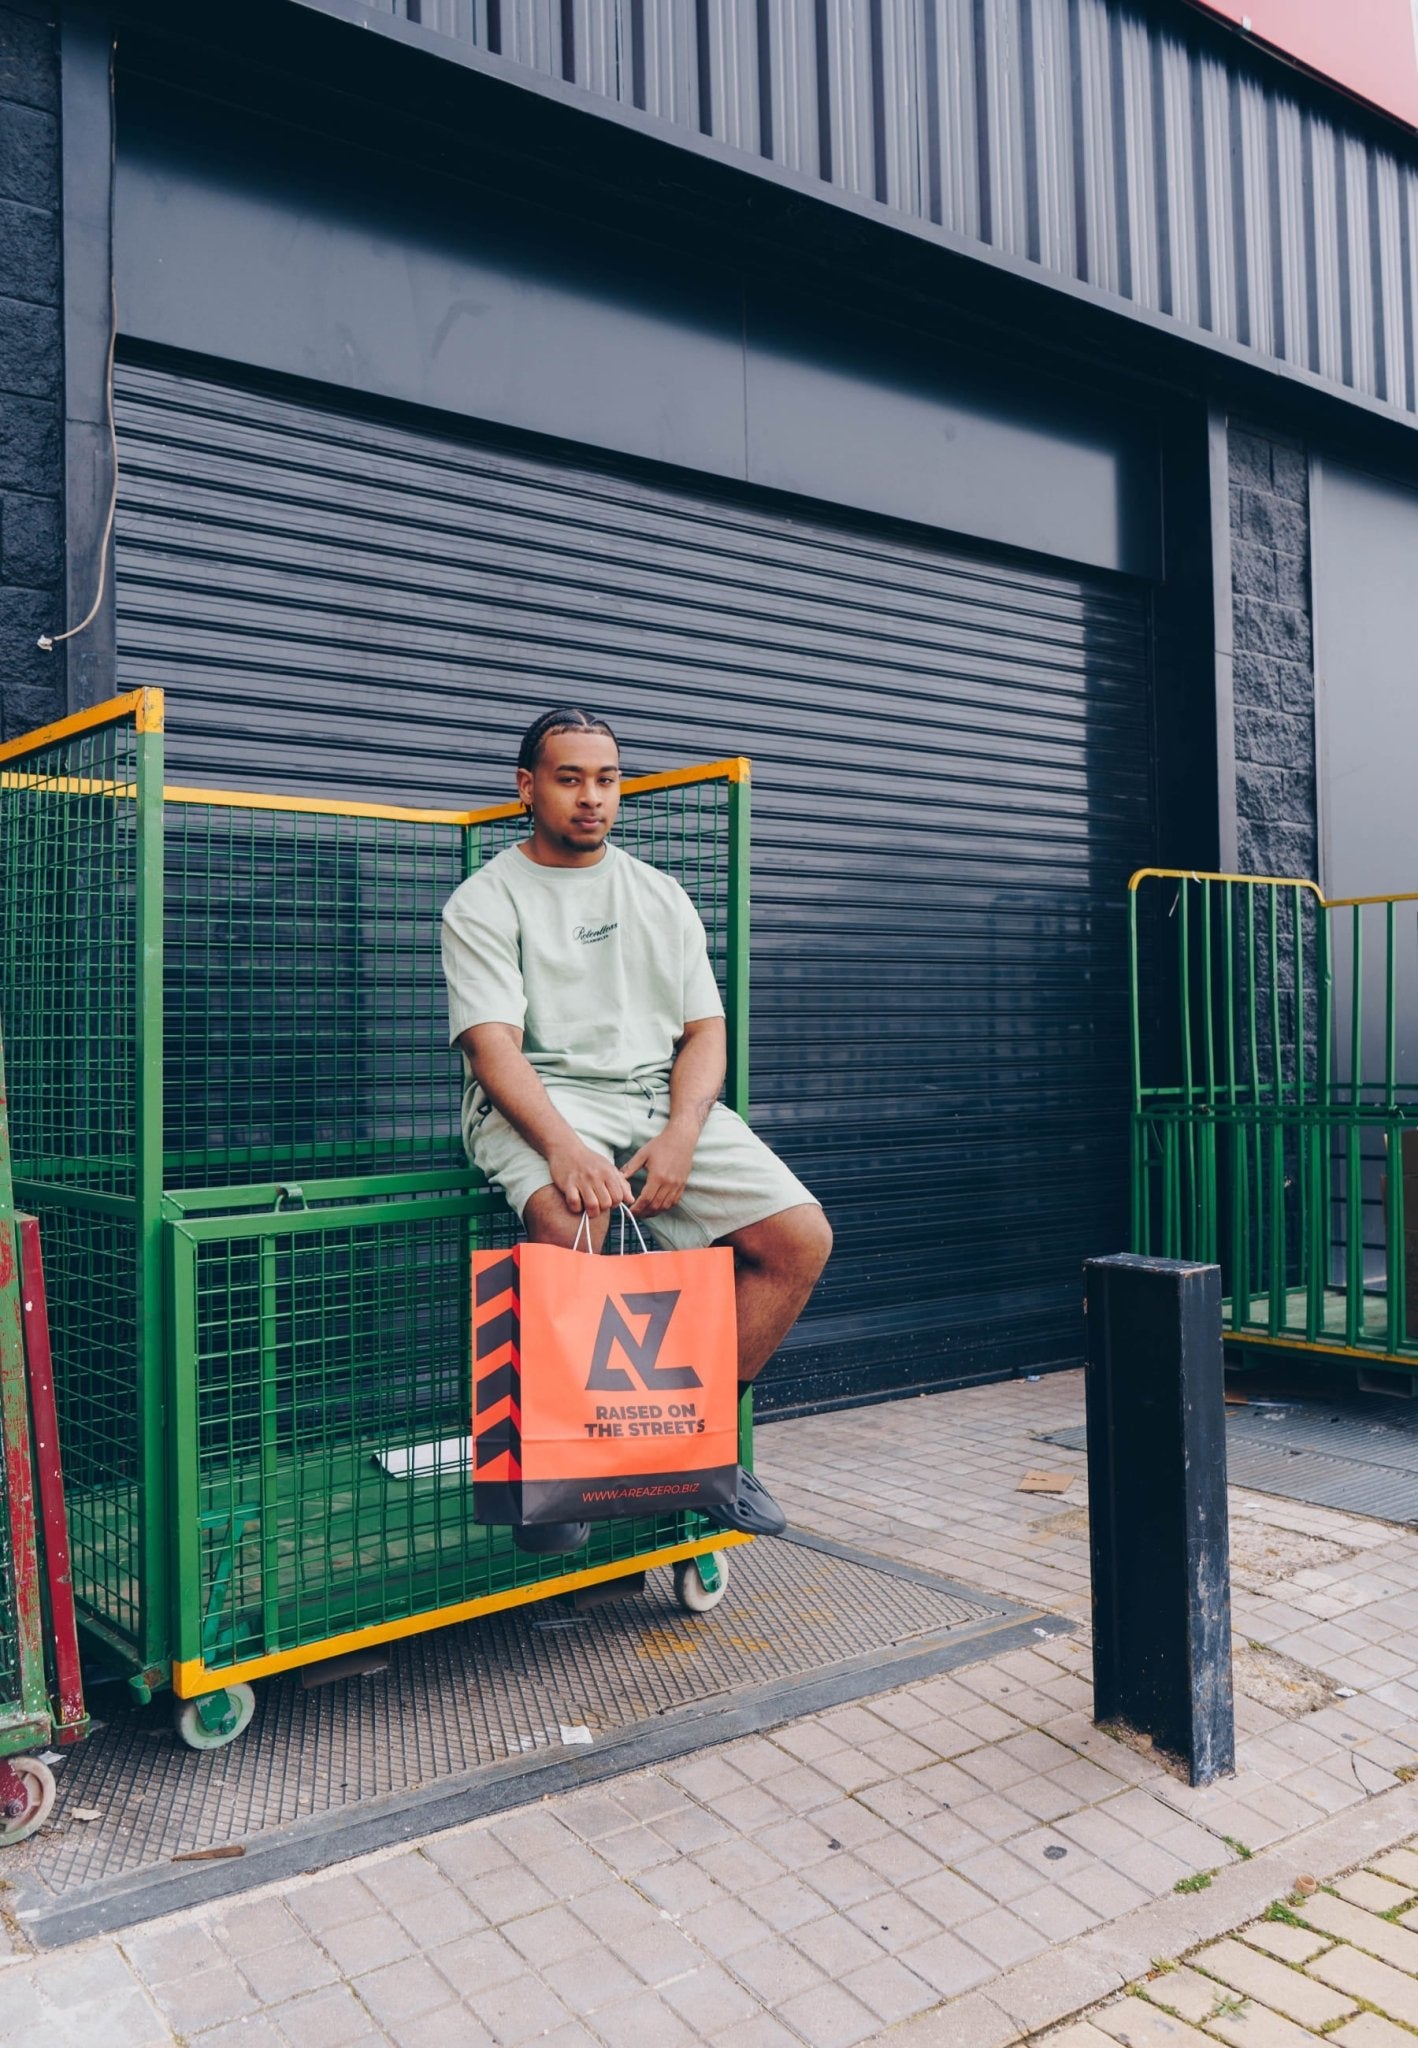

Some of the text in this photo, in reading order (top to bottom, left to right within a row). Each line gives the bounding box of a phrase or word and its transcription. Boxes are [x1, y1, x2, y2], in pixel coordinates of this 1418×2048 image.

[595, 1403, 697, 1421] RAISED ON
[584, 1418, 706, 1438] THE STREETS
[582, 1482, 701, 1503] WWW.AREAZERO.BIZ
